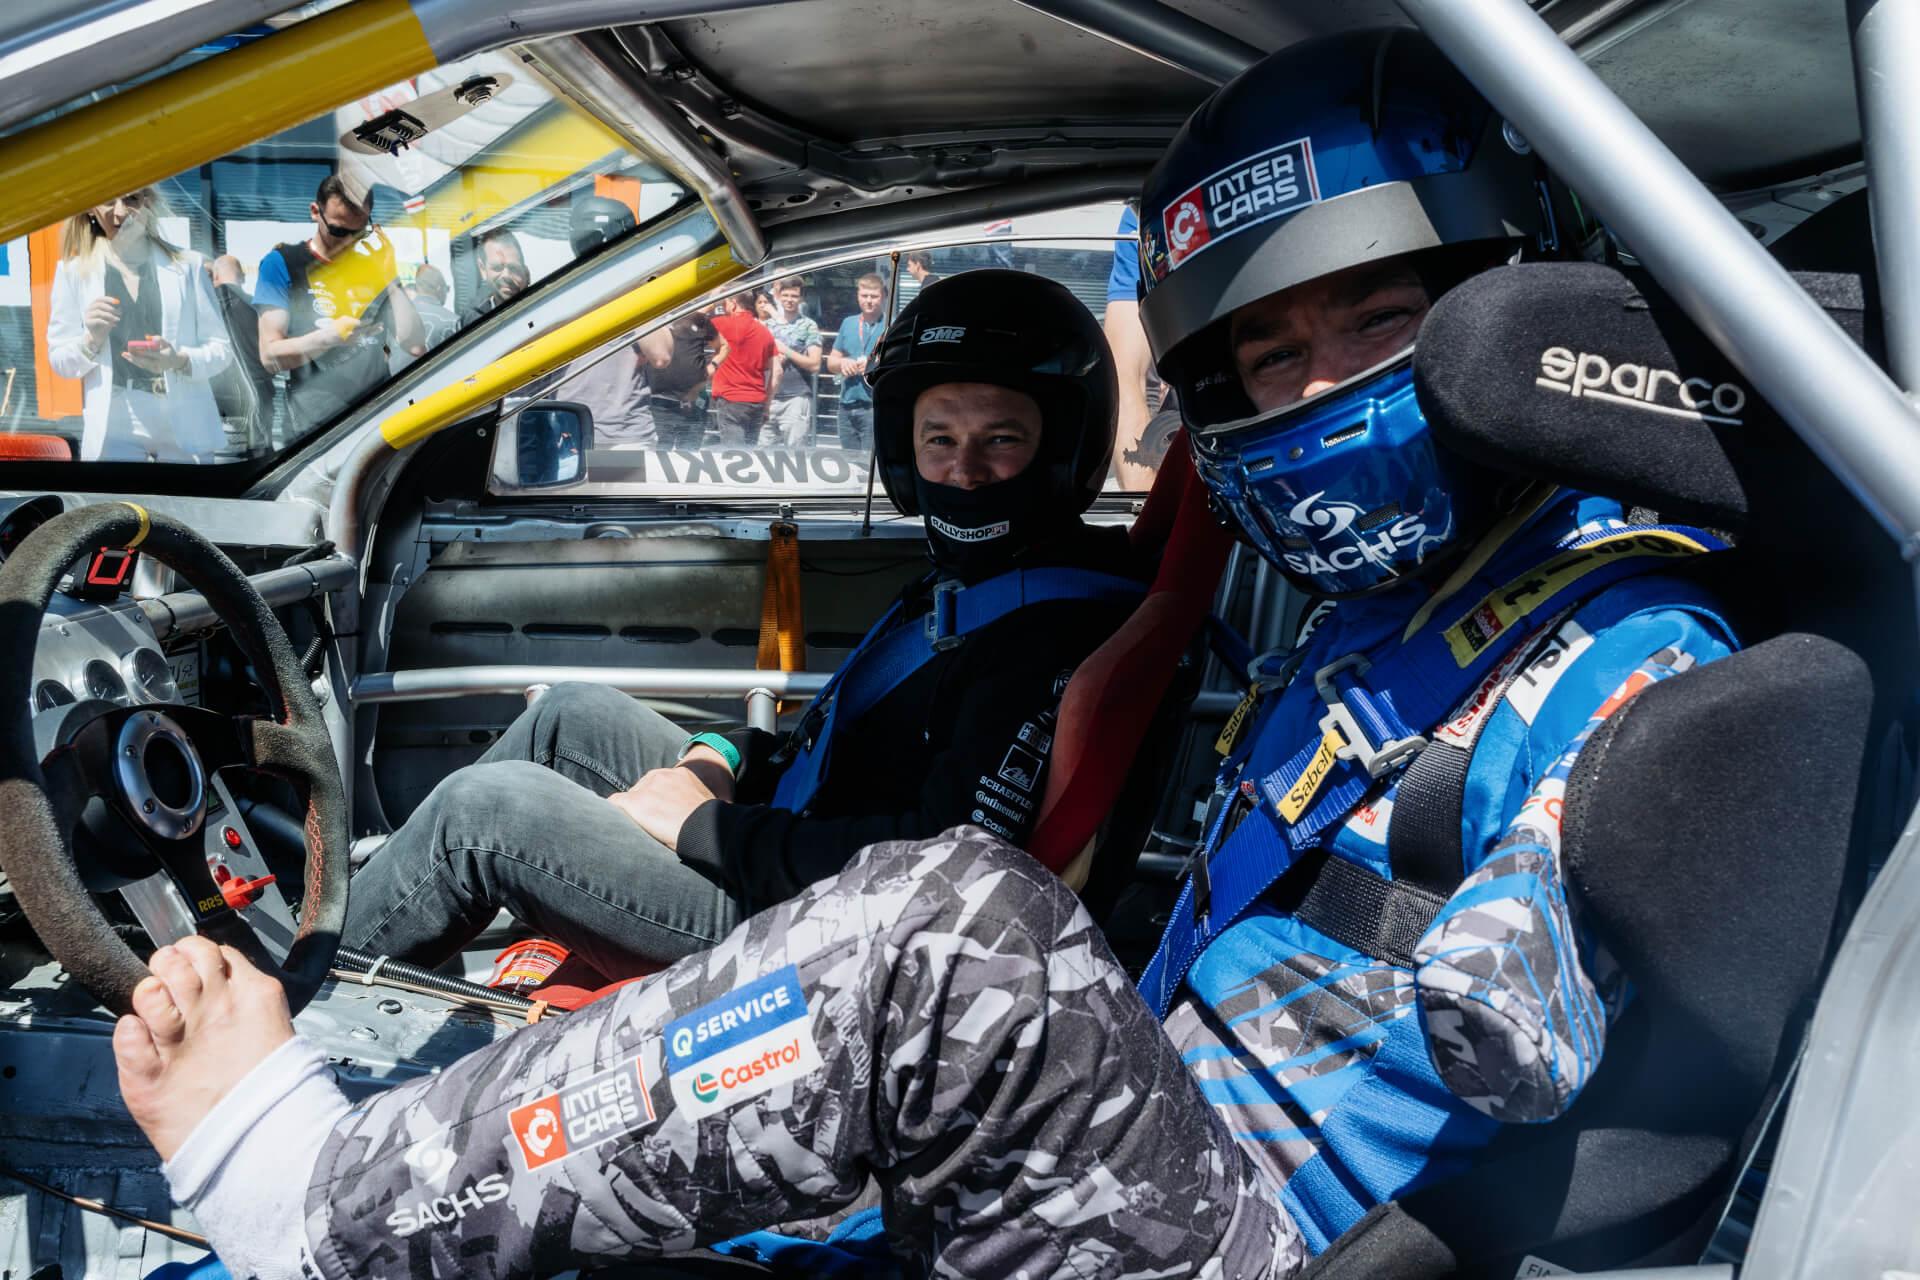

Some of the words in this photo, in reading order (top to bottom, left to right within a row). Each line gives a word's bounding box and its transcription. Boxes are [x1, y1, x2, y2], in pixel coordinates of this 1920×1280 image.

[1209, 153, 1295, 207] INTER
[1213, 176, 1299, 228] CARS
[920, 328, 965, 341] OMP
[1539, 346, 1745, 415] sparco
[1283, 515, 1427, 575] SACHS
[1290, 743, 1333, 809] Sabelt
[672, 1027, 693, 1058] Q
[696, 986, 791, 1043] SERVICE
[720, 1038, 800, 1089] Castrol
[563, 1072, 633, 1119] INTER
[568, 1096, 639, 1143] CARS
[386, 1173, 510, 1237] SACHS
